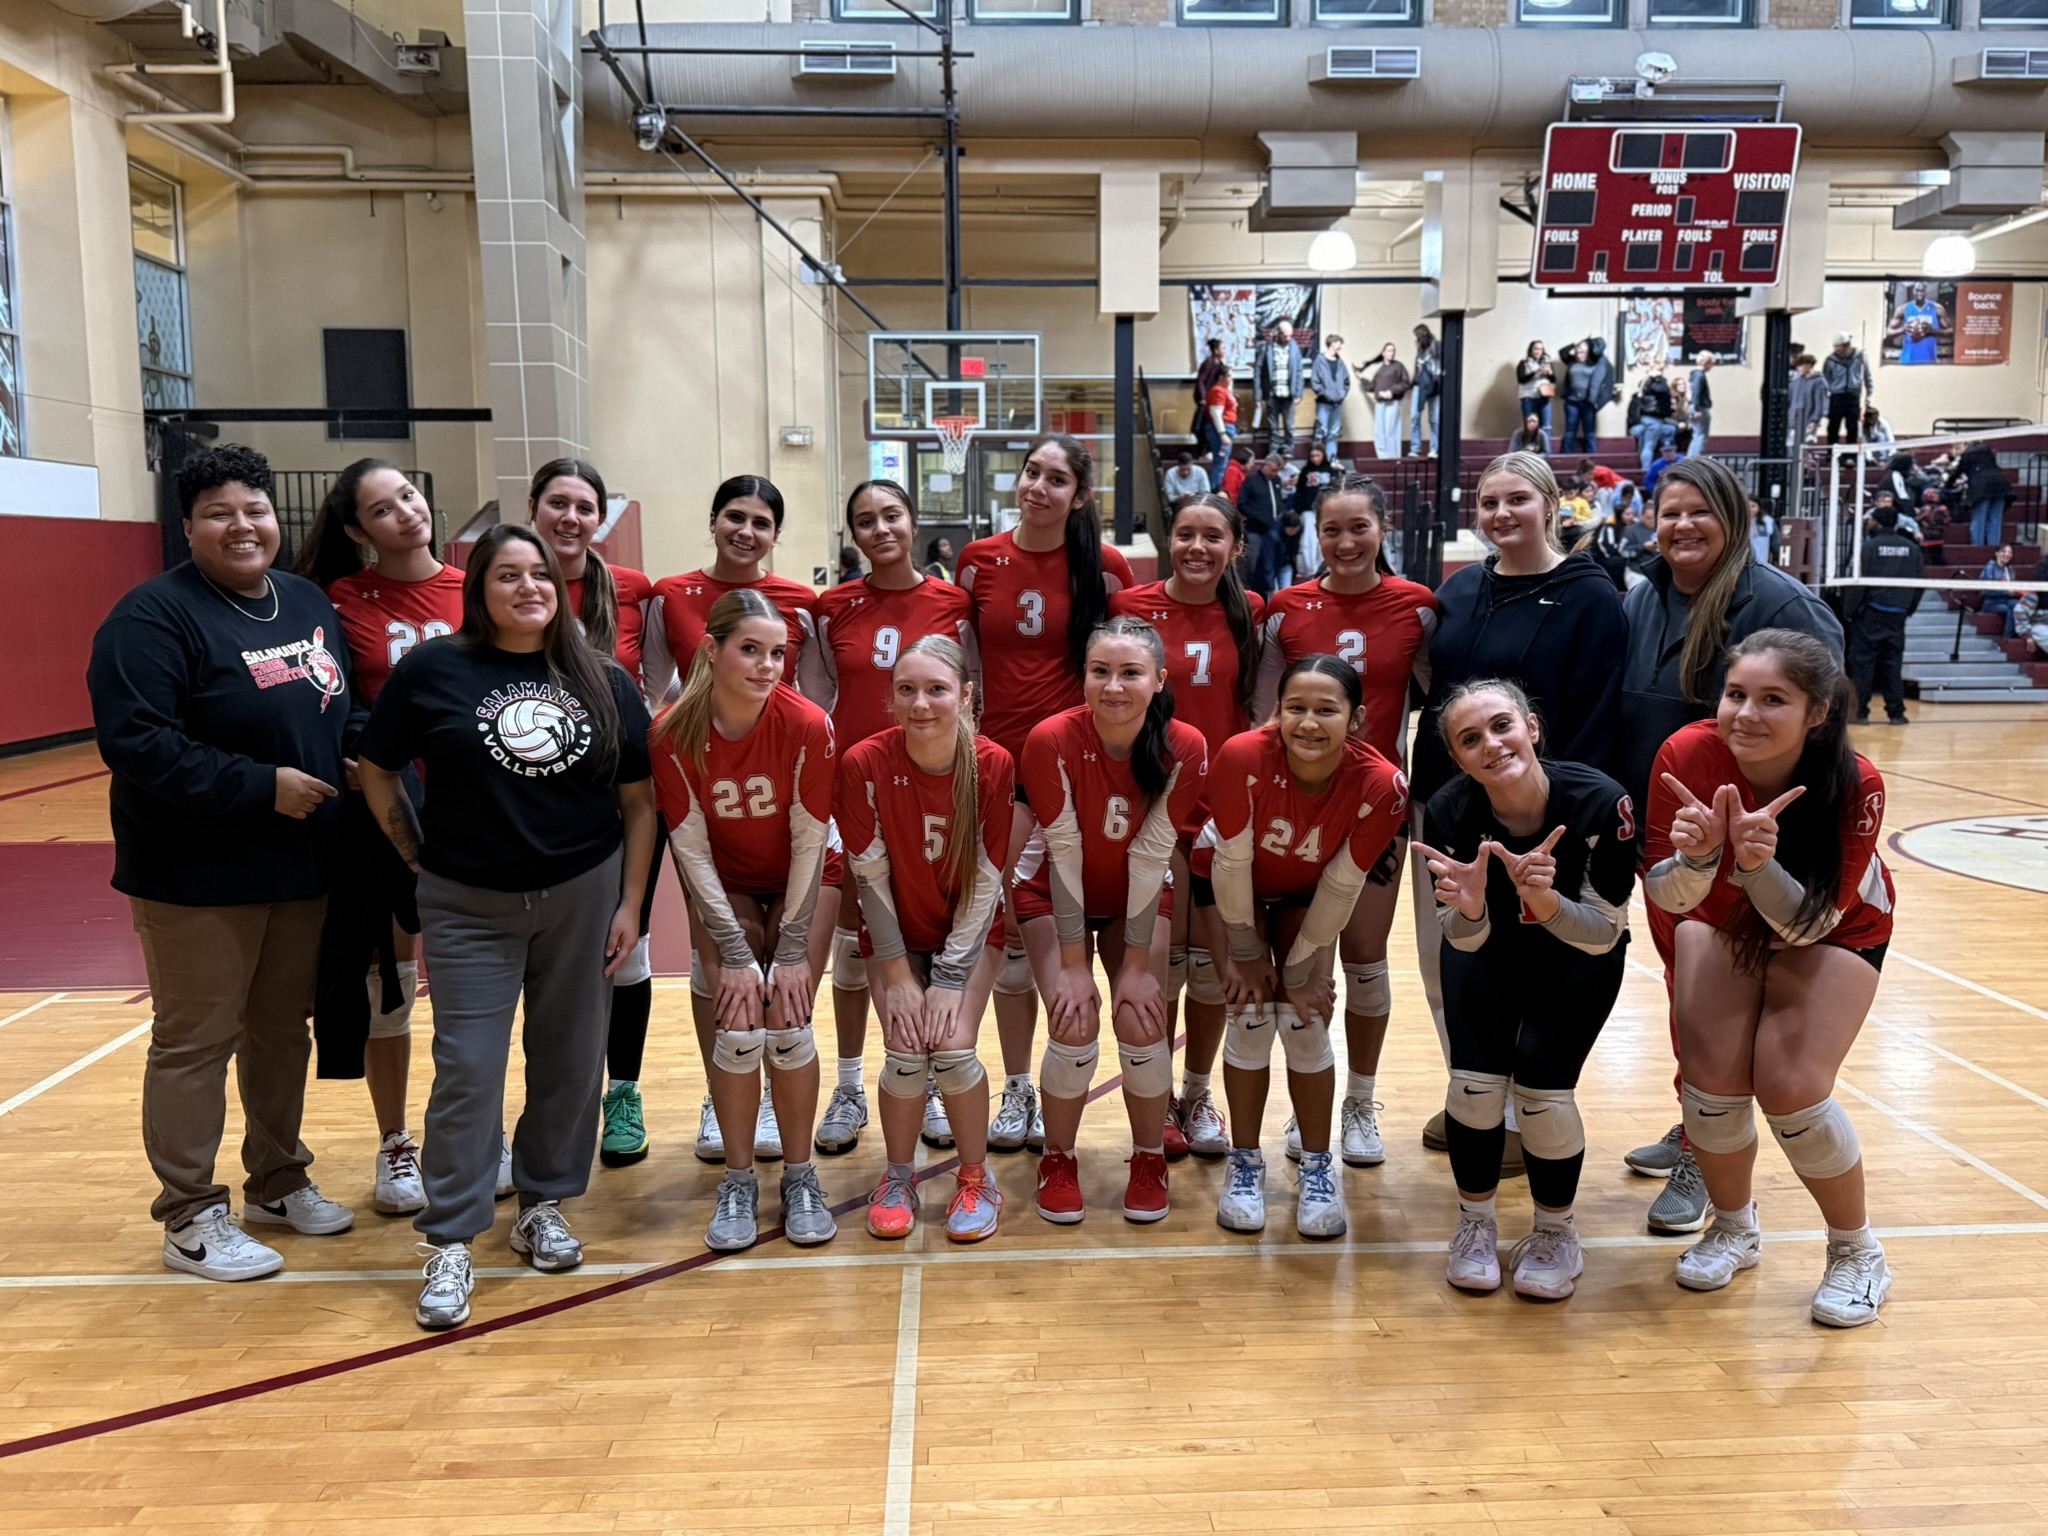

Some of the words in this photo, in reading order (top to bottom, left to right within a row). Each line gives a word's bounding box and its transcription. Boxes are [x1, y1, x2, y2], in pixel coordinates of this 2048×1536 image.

[1552, 173, 1597, 189] HOME
[1650, 172, 1687, 184] BONUS
[1656, 185, 1678, 194] POSS
[1733, 173, 1791, 189] VISITOR
[1631, 204, 1672, 216] PERIOD
[1544, 230, 1579, 242] FOULS
[1621, 230, 1663, 242] PLAYER
[1677, 230, 1712, 242] FOULS
[1743, 230, 1778, 242] FOULS
[1588, 271, 1609, 283] TOL
[1703, 271, 1724, 283] TOL
[1968, 292, 2002, 301] Bounce
[1016, 589, 1045, 638] 3
[241, 639, 315, 666] SALAMANCA
[872, 625, 901, 670] 9
[1336, 629, 1367, 674] 2
[248, 658, 289, 677] CROSS
[1185, 641, 1211, 686] 7
[475, 682, 589, 722] SALAMANCA
[483, 733, 592, 777] VOLLEYBALL
[711, 773, 779, 820] 22
[1103, 794, 1131, 841] 6
[1617, 794, 1636, 841] S
[1856, 791, 1883, 836] S
[922, 813, 949, 864] 5
[1260, 816, 1323, 864] 24
